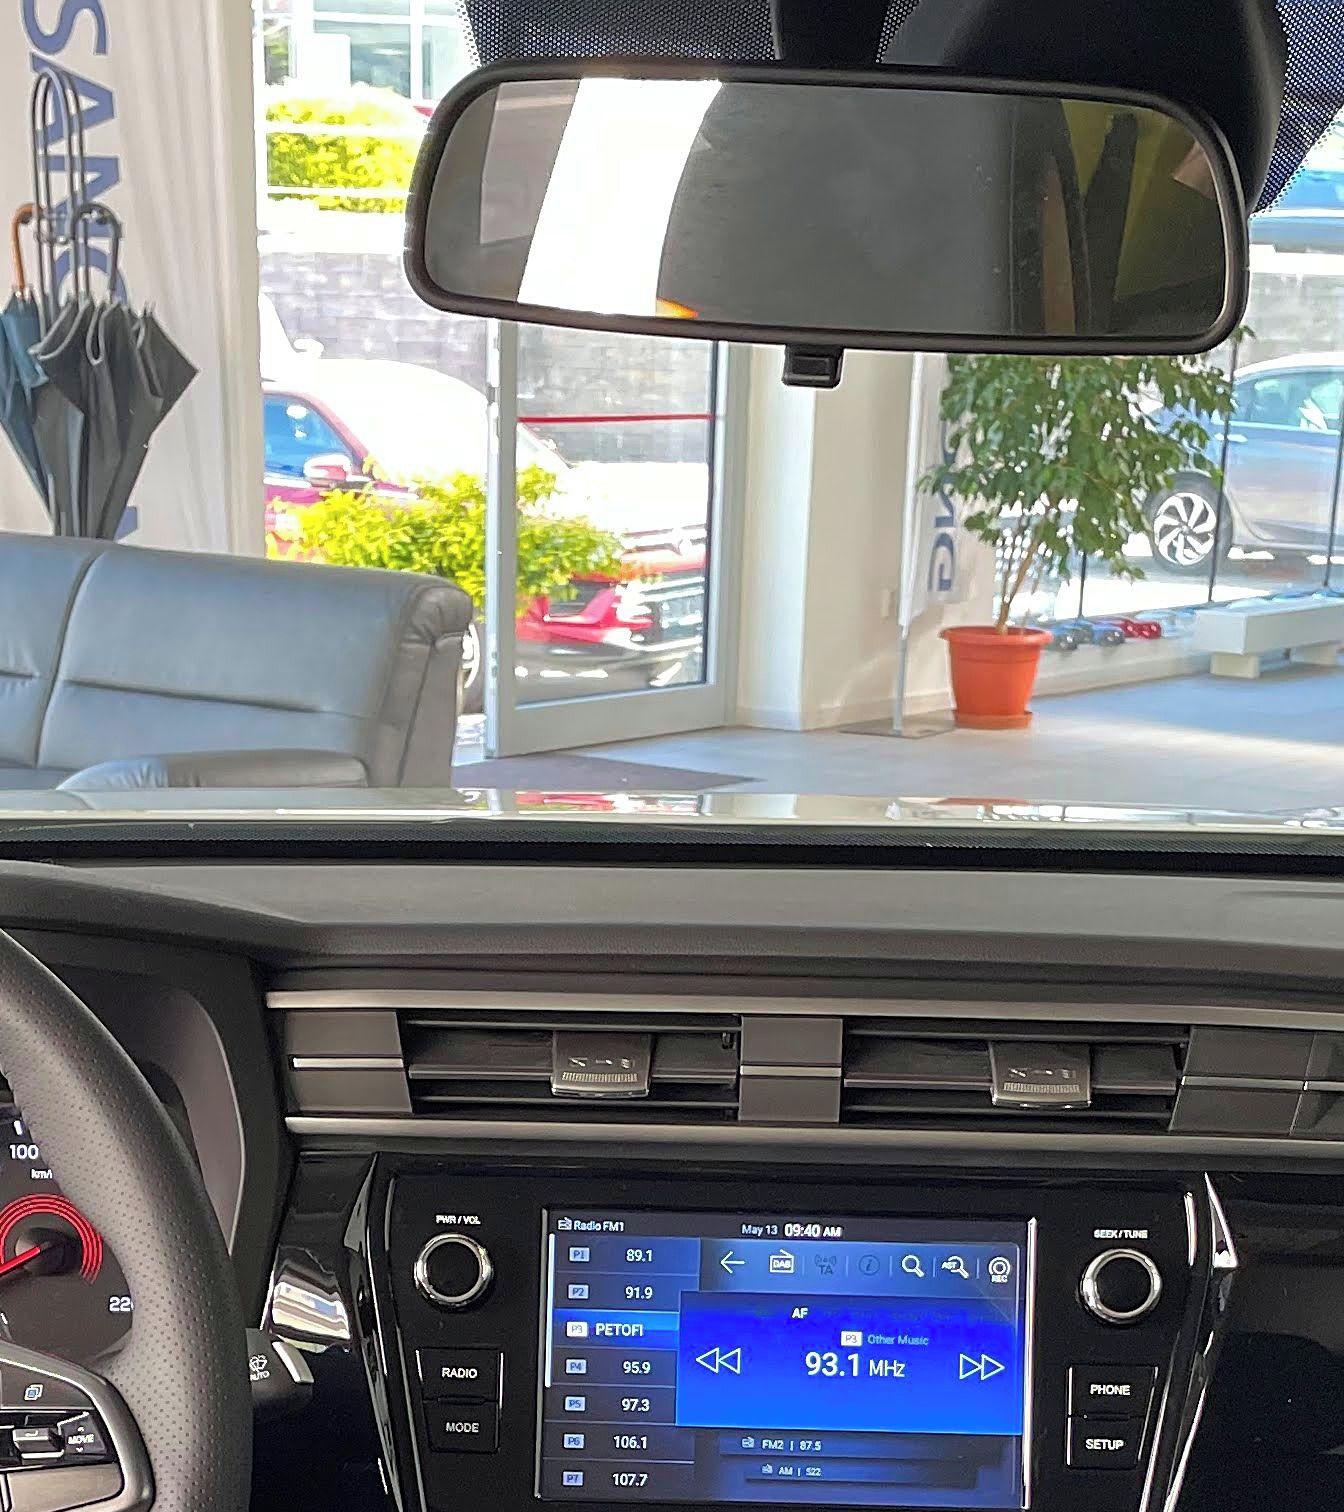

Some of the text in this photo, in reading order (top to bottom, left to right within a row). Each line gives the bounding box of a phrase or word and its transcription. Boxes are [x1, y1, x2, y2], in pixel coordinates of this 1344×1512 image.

[10, 1145, 39, 1159] 100
[573, 1221, 624, 1231] Radio FM1
[742, 1224, 842, 1237] May 13 09:40 AM
[626, 1249, 653, 1262] 89.1
[625, 1287, 653, 1299] 91.9
[109, 1297, 134, 1311] 22
[792, 1308, 808, 1319] AF
[595, 1323, 644, 1336] PETOFI
[867, 1335, 895, 1345] Other
[898, 1335, 929, 1345] Music
[623, 1361, 651, 1374] 95.9
[805, 1352, 905, 1377] 93.1 MHz
[442, 1368, 477, 1378] RADIO
[1090, 1385, 1130, 1396] PHONE
[621, 1398, 650, 1412] 97.3
[446, 1422, 479, 1433] MODE
[614, 1436, 647, 1449] 106.1
[762, 1440, 821, 1451] FM2 87.5
[1086, 1439, 1124, 1450] SETUP
[613, 1473, 648, 1486] 107.7
